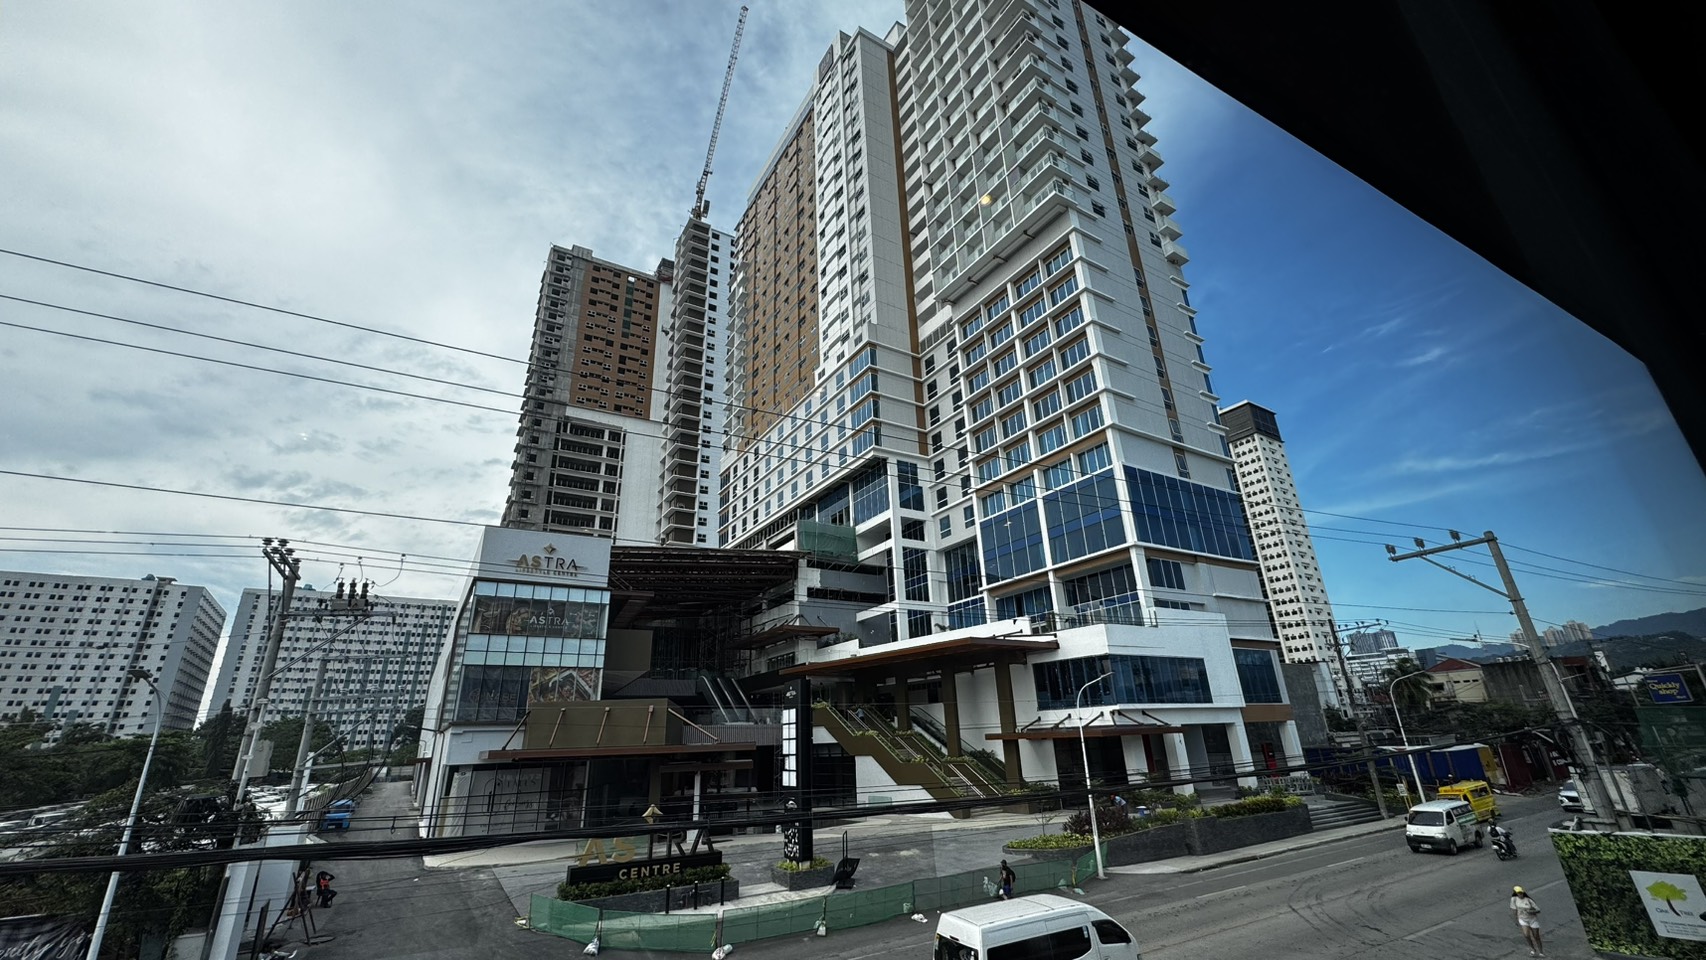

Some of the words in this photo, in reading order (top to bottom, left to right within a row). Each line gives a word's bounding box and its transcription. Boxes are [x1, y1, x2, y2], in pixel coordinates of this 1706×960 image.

[516, 554, 579, 571] ASTRA
[529, 615, 569, 626] ASTRA
[577, 828, 715, 867] ASTRA
[618, 862, 681, 880] CENTRE
